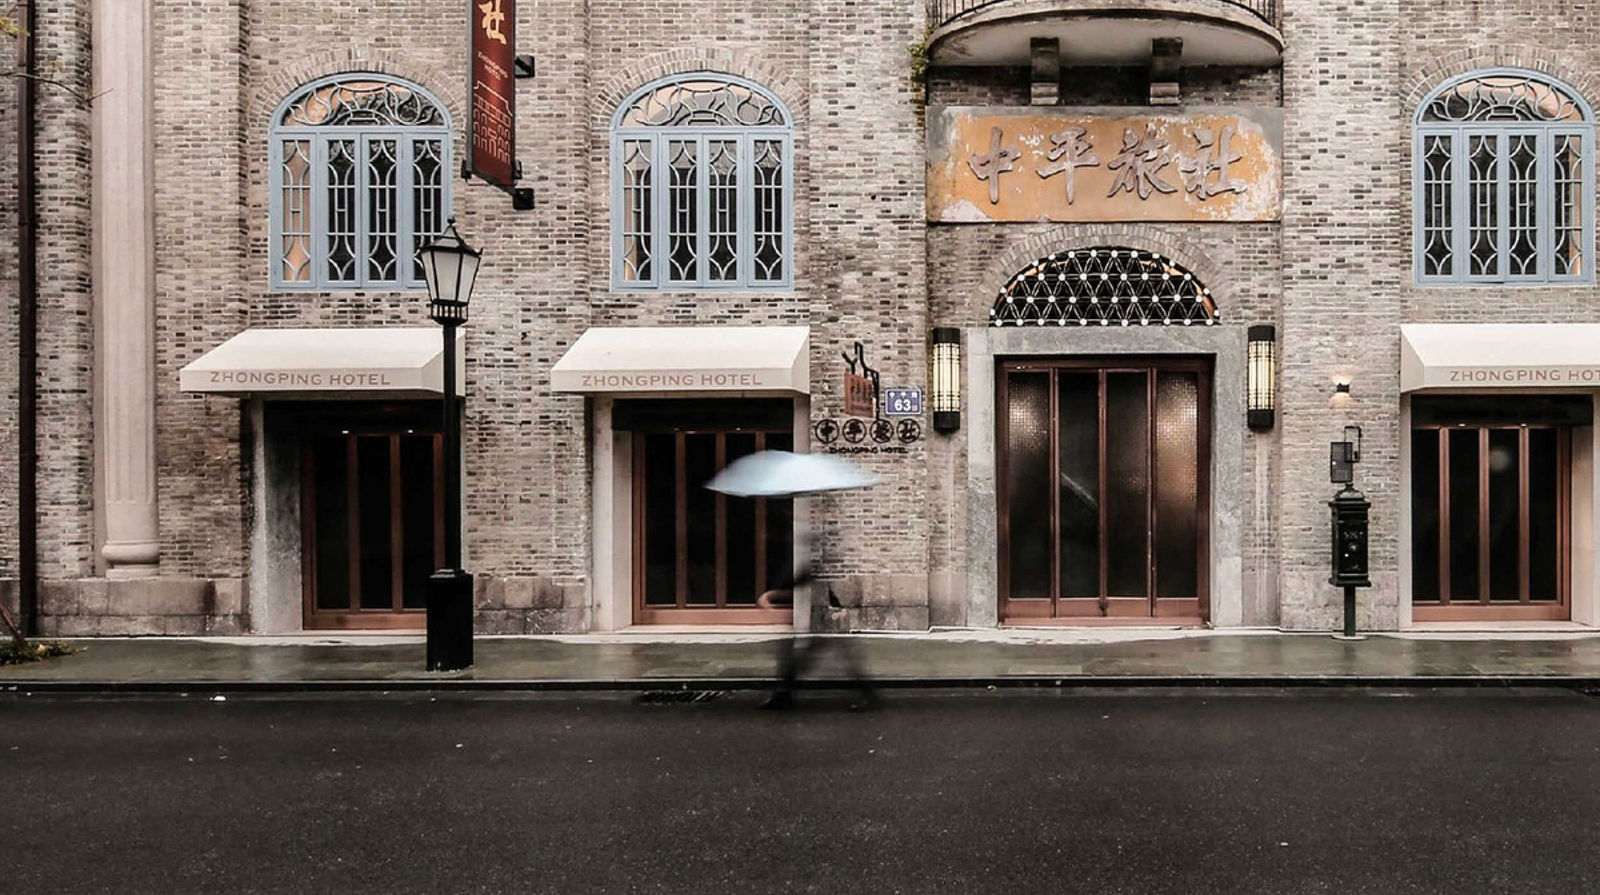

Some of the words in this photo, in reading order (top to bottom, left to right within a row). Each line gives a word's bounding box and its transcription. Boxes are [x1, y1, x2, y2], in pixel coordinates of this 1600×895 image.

[967, 124, 1248, 205] 中平旅社
[210, 371, 322, 386] ZHONGPING
[329, 373, 391, 386] HOTEL
[582, 374, 694, 387] ZHONGPING
[701, 373, 762, 386] HOTEL
[1450, 369, 1561, 382] ZHONGPING
[894, 398, 911, 412] 63
